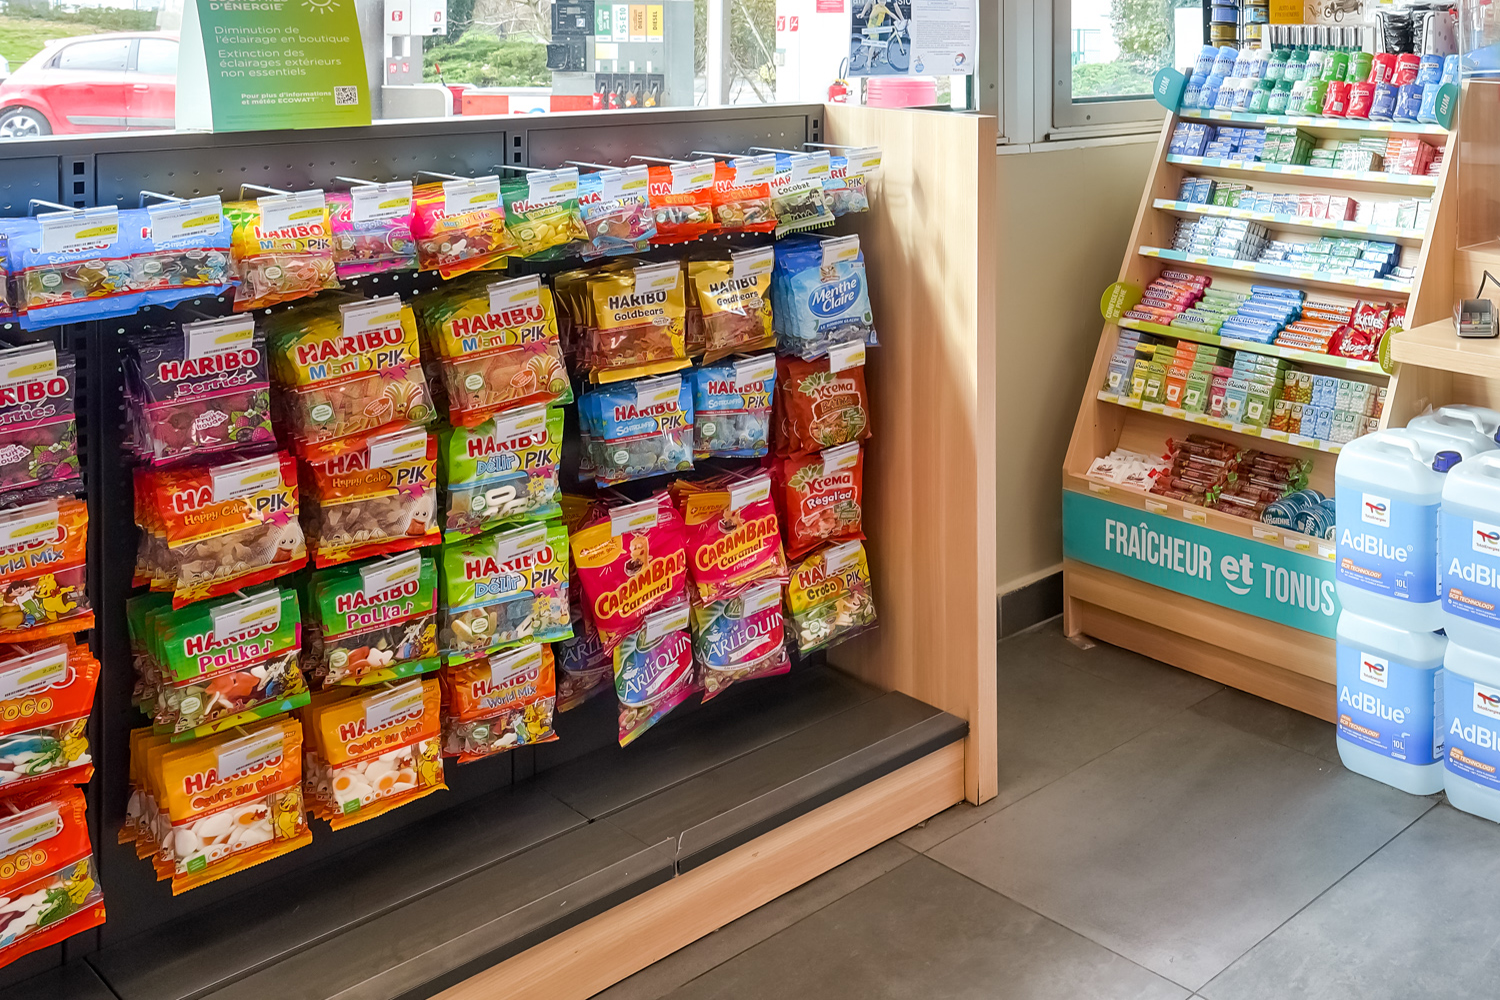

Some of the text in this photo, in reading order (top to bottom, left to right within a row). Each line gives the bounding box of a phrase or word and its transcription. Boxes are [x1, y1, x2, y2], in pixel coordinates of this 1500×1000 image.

[214, 26, 299, 35] Diminution de
[216, 36, 277, 45] l'éclairage
[299, 35, 350, 44] boutique
[218, 49, 305, 58] Extinction des
[220, 58, 341, 68] éclairages extérieurs
[249, 67, 306, 77] essentiels
[1438, 93, 1450, 115] GUM
[608, 289, 668, 310] HARIBO
[811, 278, 858, 306] Menthe
[821, 291, 855, 313] Claire
[1105, 284, 1122, 319] CONFISERIE
[1117, 289, 1127, 308] POCHE
[614, 307, 664, 322] Goldbears
[1178, 313, 1205, 323] mentos
[297, 326, 404, 366] HARIBO
[159, 348, 261, 383] HARIBO
[309, 356, 359, 381] Miami
[177, 374, 249, 397] Berries
[1228, 379, 1247, 390] Ricola
[184, 504, 247, 527] Happy Cola
[695, 513, 780, 572] CARAMBAR
[720, 541, 764, 570] Caramel
[1105, 518, 1335, 617] FRAÎCHEUR et TONUS
[806, 582, 837, 600] Croco
